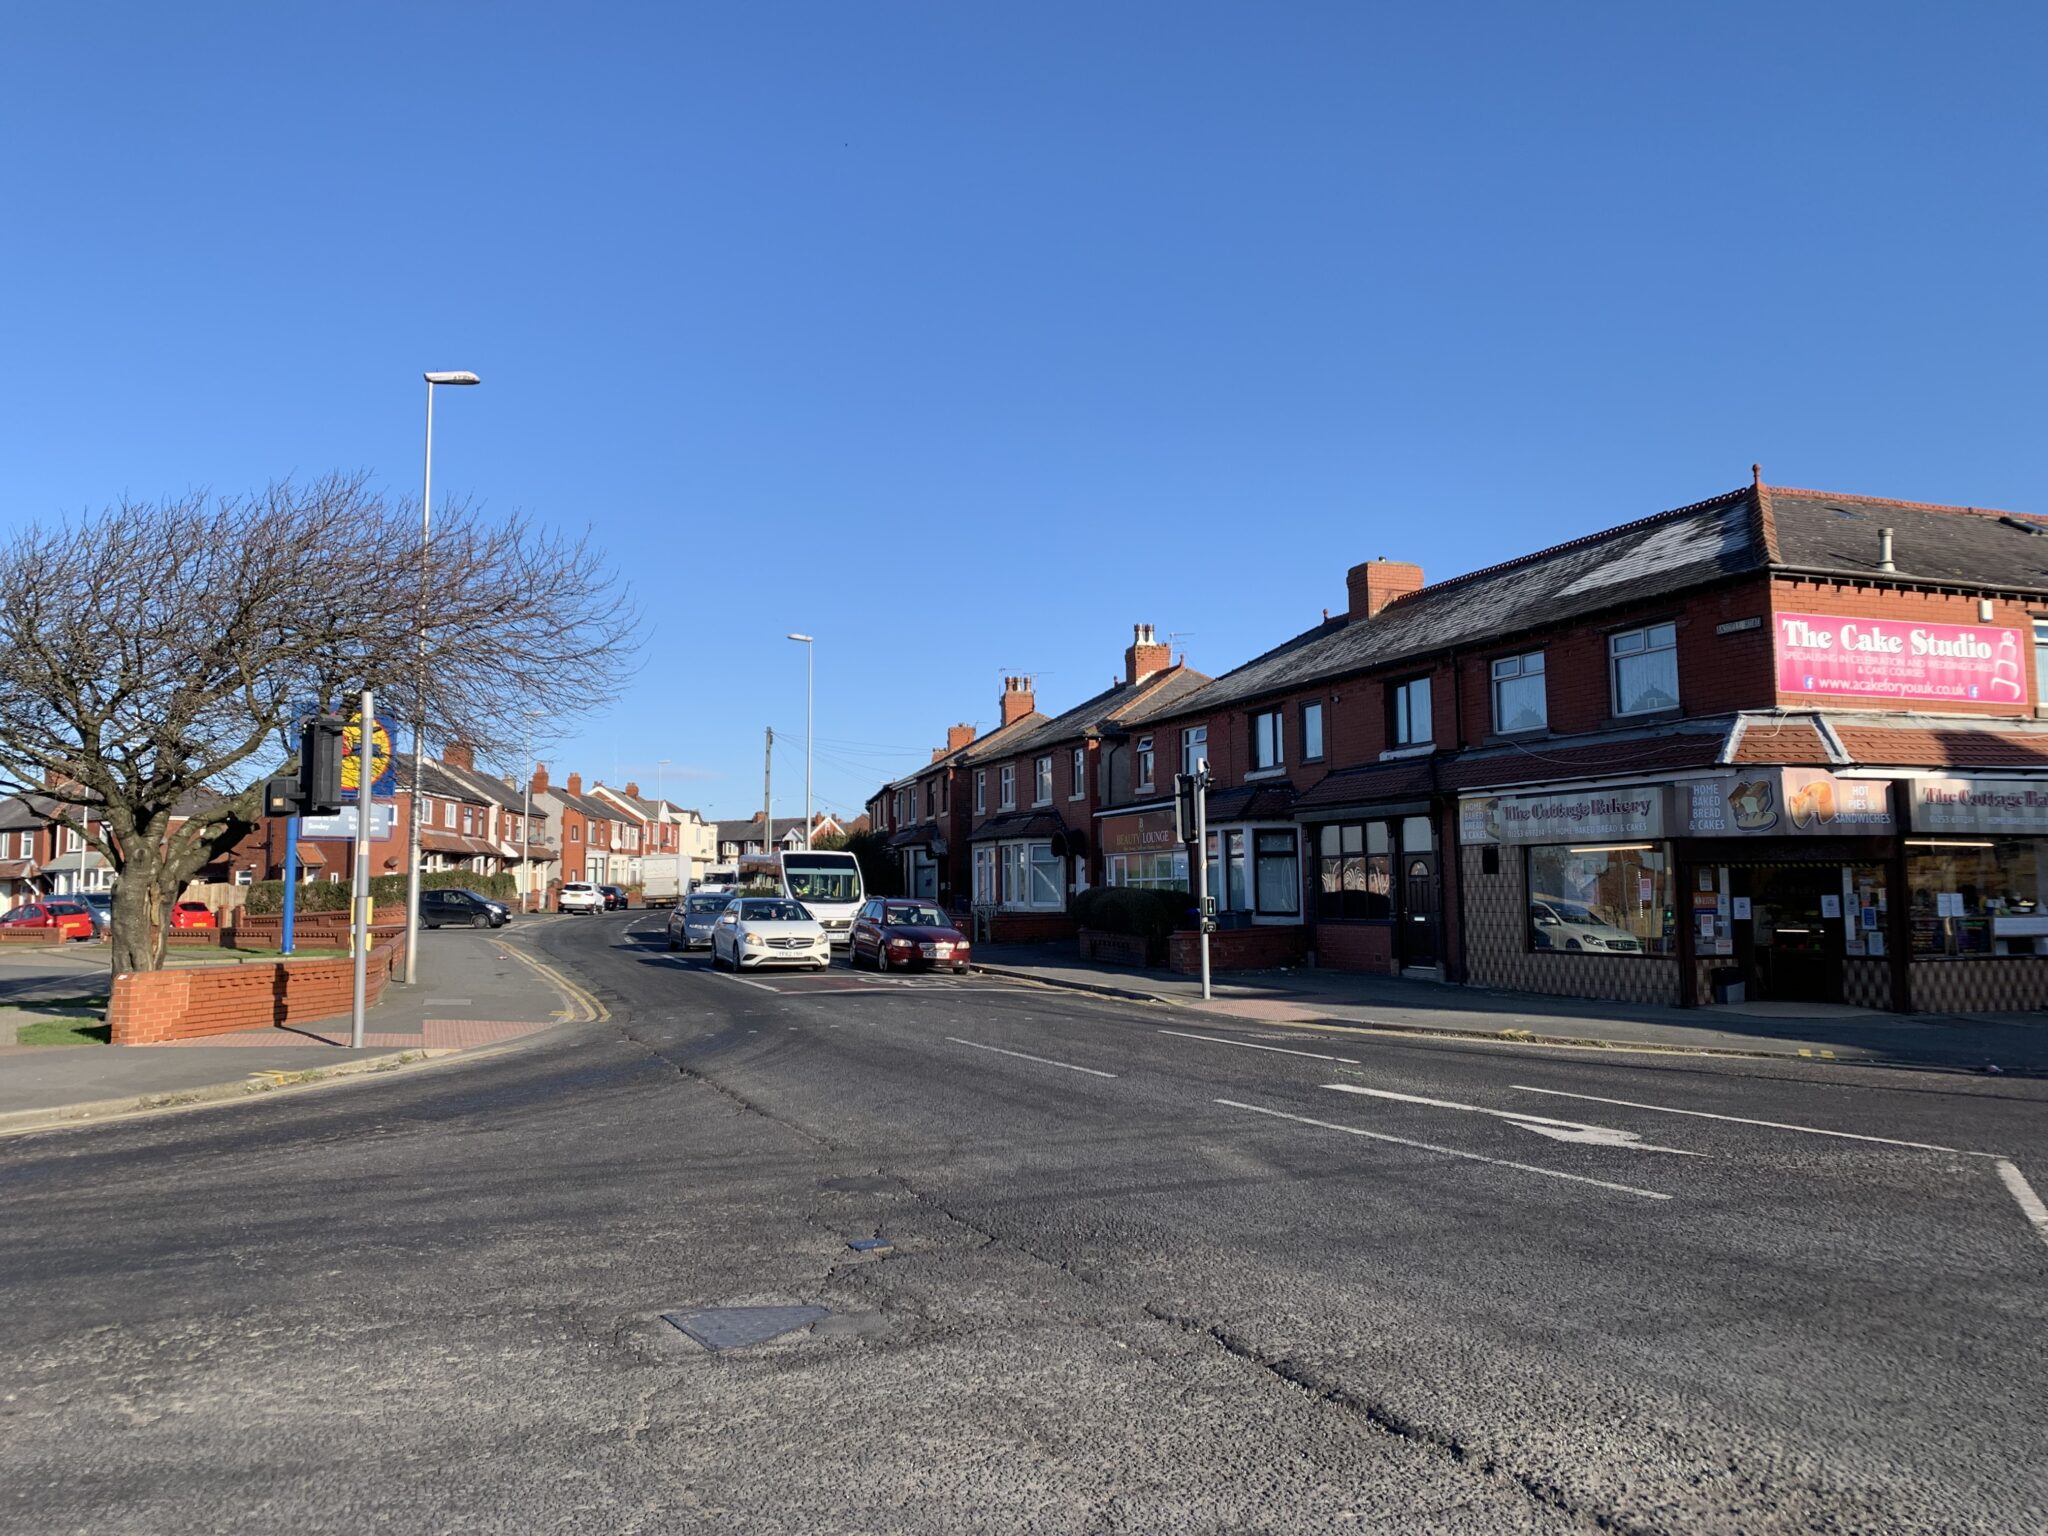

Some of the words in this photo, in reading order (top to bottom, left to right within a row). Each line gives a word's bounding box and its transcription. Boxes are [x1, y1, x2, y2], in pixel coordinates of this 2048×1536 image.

[1781, 618, 1834, 649] The
[1840, 623, 1904, 653] Cake
[1910, 629, 1992, 659] Studio
[1865, 666, 1888, 675] CAKE
[1693, 784, 1719, 795] HOME
[1852, 786, 1869, 796] HOT
[1692, 796, 1721, 807] BAKED
[1849, 799, 1867, 810] PIES
[1923, 787, 1957, 805] The
[1959, 789, 2023, 811] Cottage
[1503, 805, 1531, 821] The
[1532, 802, 1590, 821] Cottage
[1591, 798, 1652, 817] Bakery
[1692, 808, 1721, 818] BREAD
[1835, 813, 1891, 824] SANDWICHES
[1627, 822, 1647, 832] CAKES
[1689, 821, 1696, 831] &
[1697, 819, 1725, 830] CAKES
[1117, 833, 1140, 845] BEAUTY
[1142, 830, 1169, 843] LOUNGE
